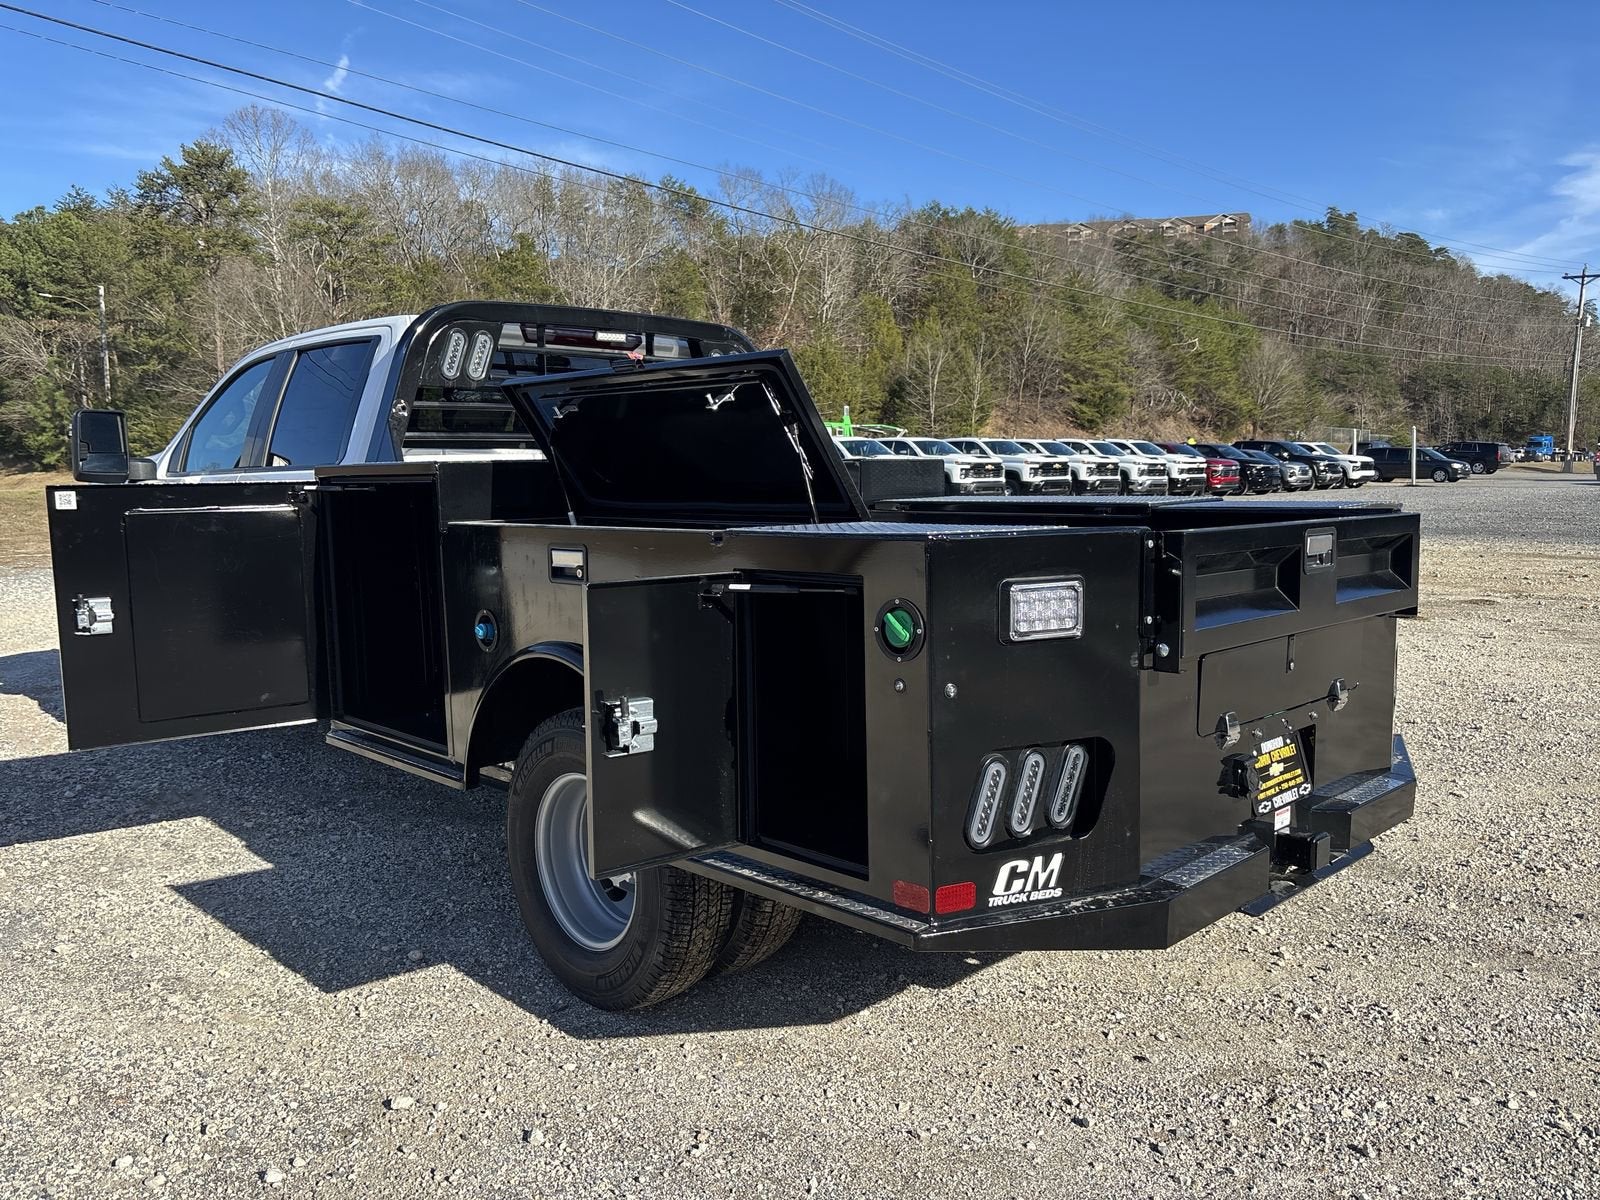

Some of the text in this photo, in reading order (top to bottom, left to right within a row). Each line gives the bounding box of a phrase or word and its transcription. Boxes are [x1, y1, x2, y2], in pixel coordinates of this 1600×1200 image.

[992, 852, 1063, 896] CM
[988, 888, 1063, 907] TRUCK BEDS
